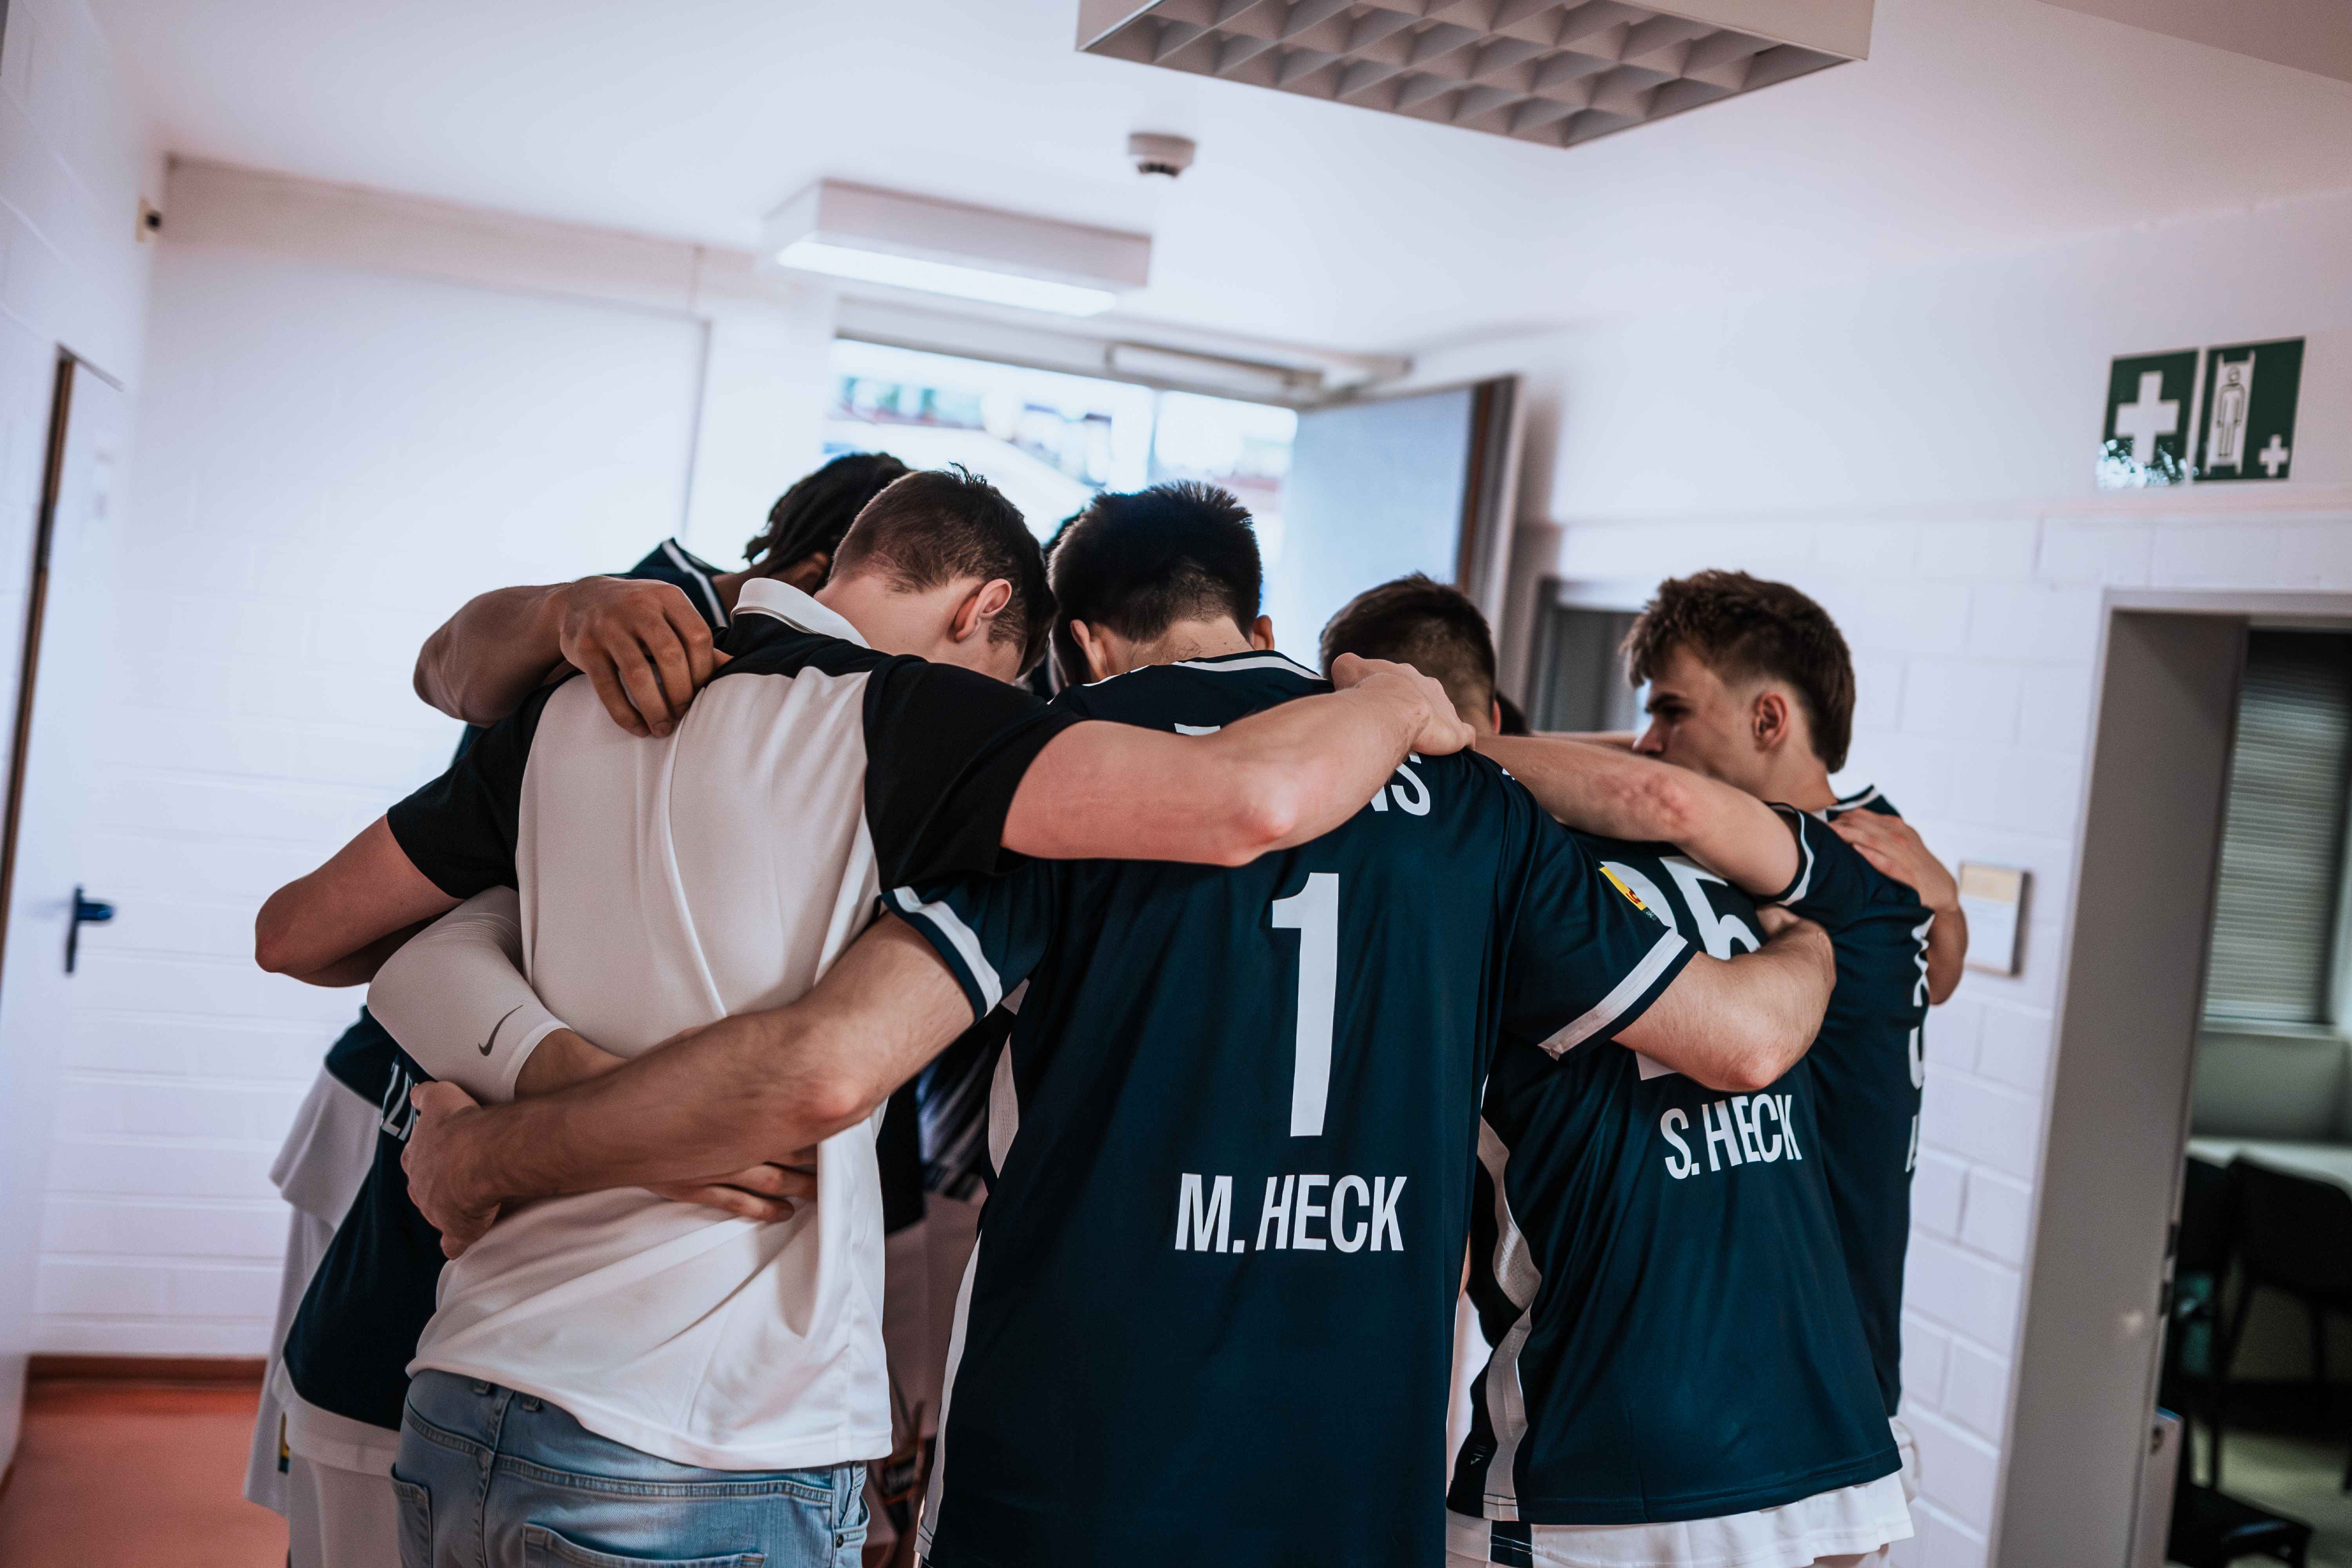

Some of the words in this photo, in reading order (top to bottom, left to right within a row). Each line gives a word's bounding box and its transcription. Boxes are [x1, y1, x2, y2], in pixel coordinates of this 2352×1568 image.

[1272, 872, 1339, 1137] 1
[1660, 1108, 1700, 1179] S.
[1702, 1094, 1802, 1172] HECK
[1175, 1173, 1245, 1253] M.
[1255, 1174, 1407, 1253] HECK
